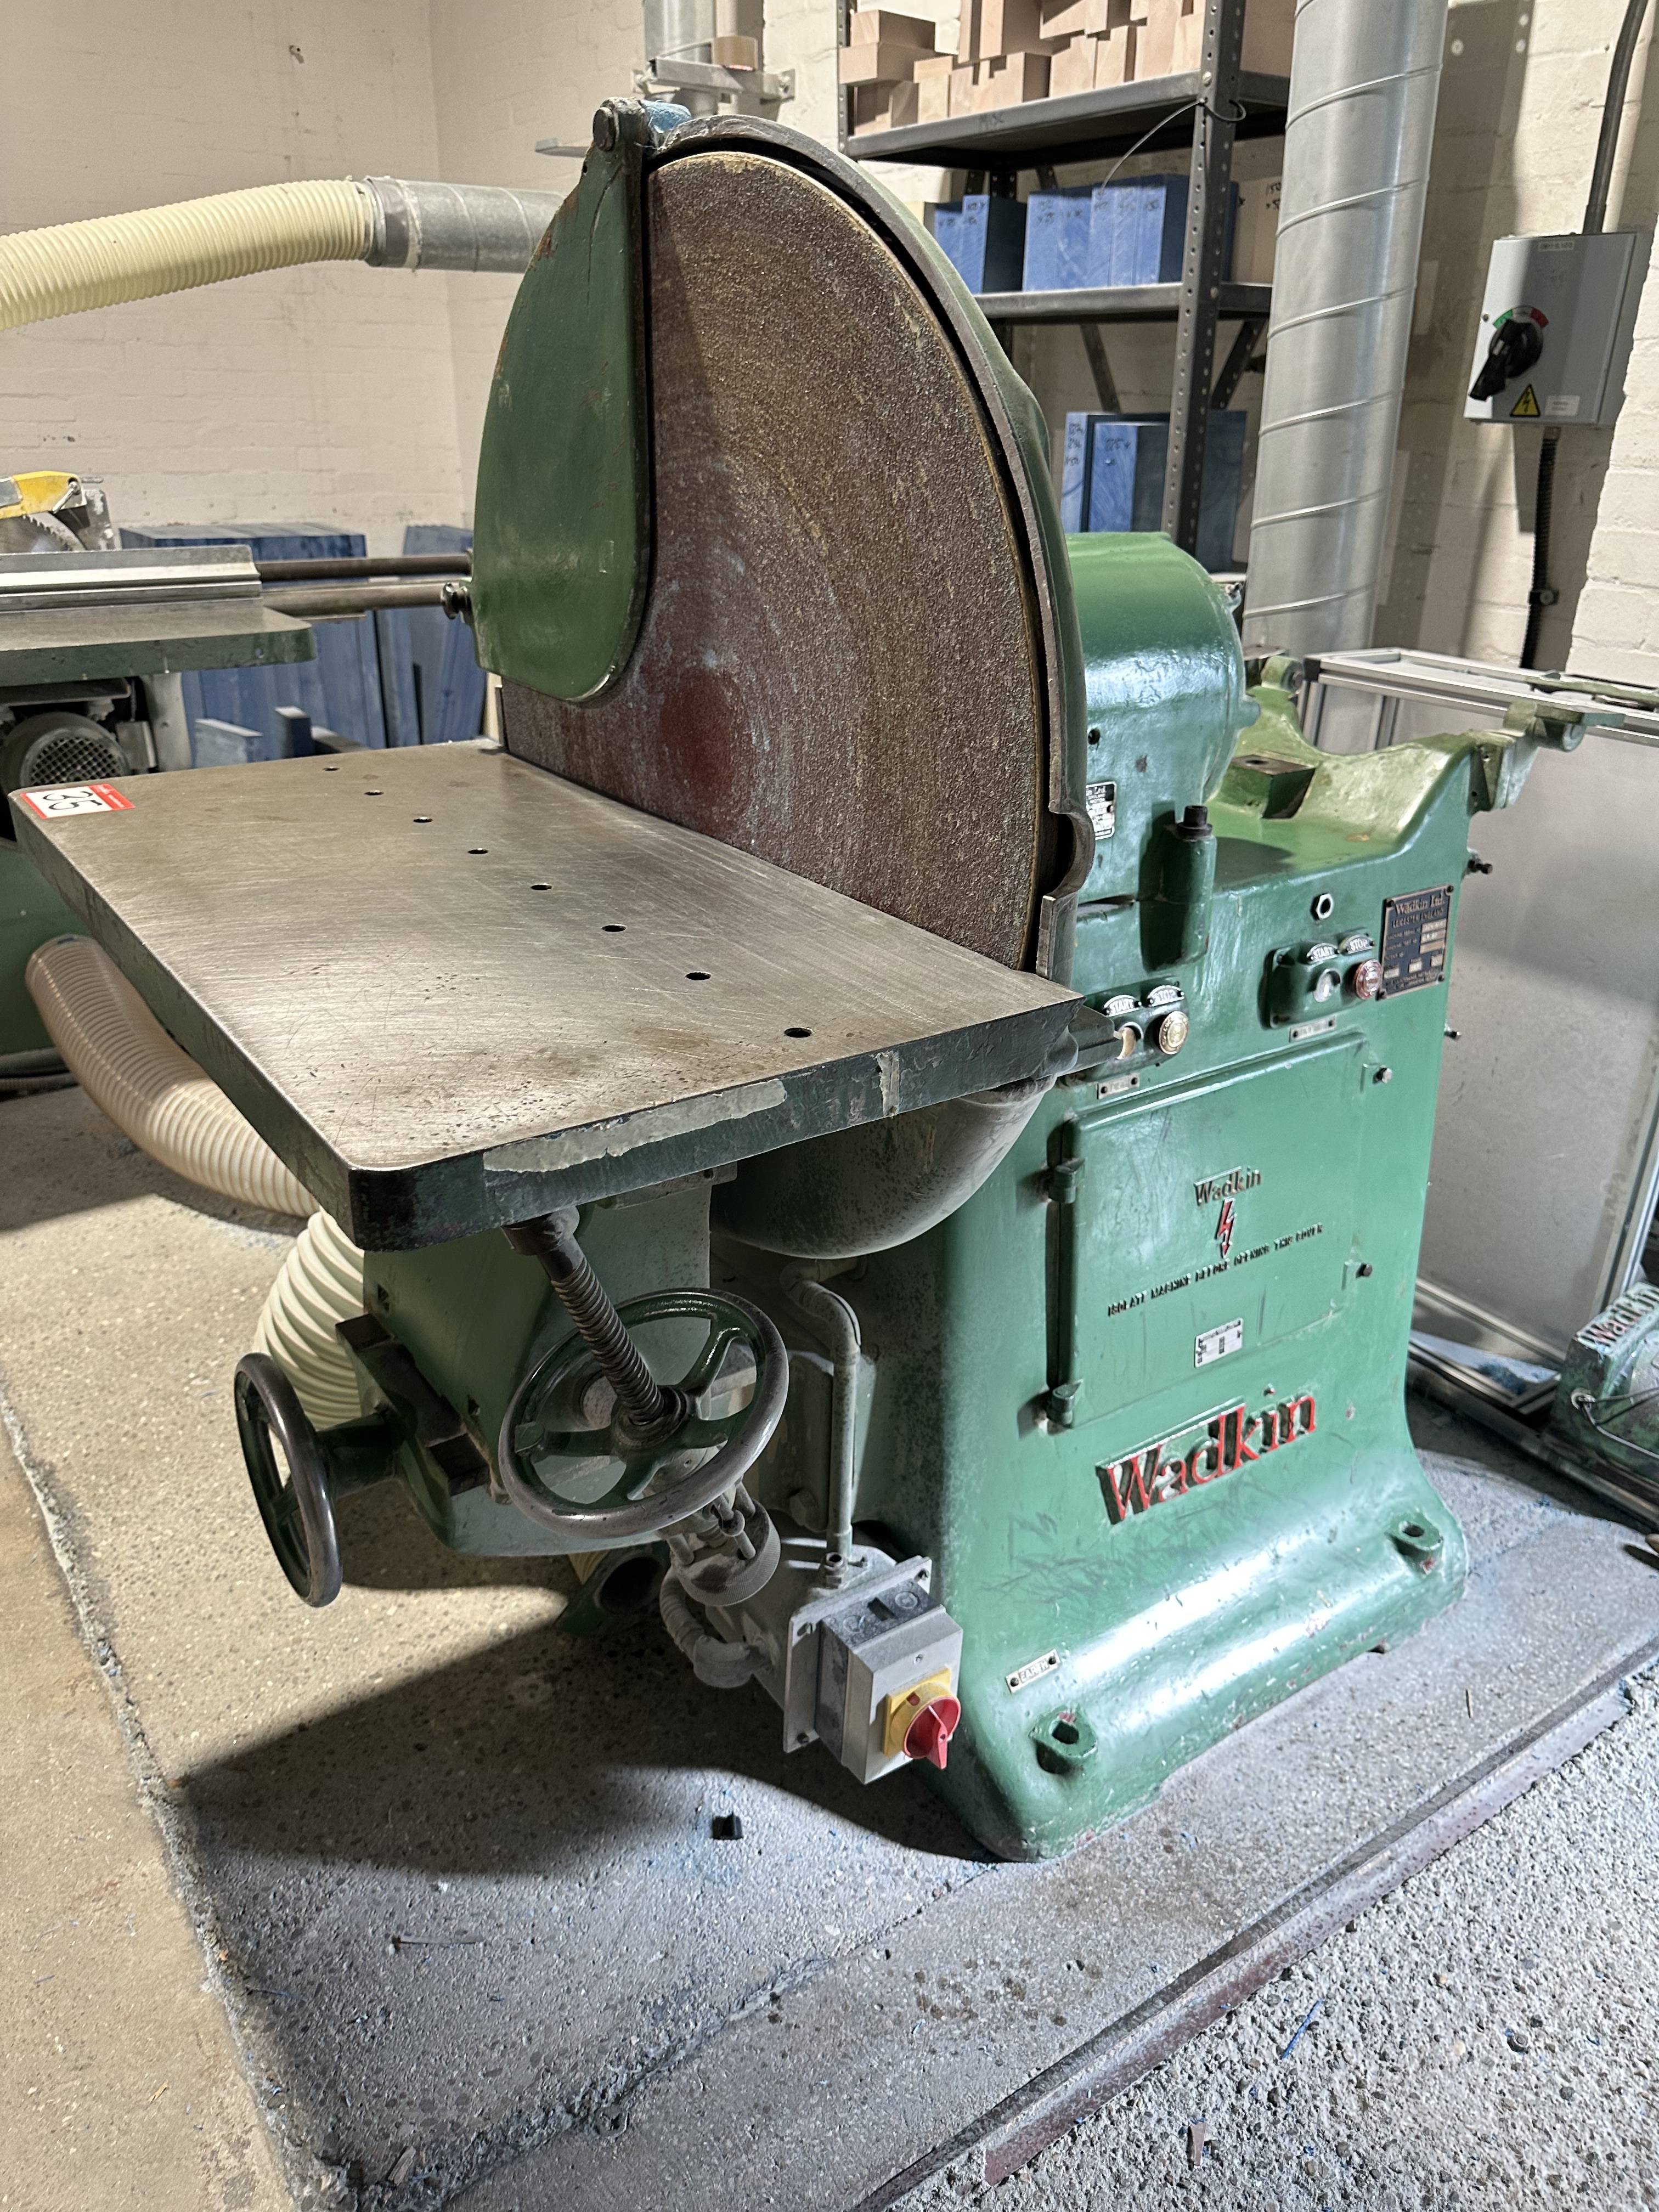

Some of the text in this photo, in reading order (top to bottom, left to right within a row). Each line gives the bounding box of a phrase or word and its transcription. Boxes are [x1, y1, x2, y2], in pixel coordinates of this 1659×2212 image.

[42, 791, 103, 810] 35
[1396, 899, 1427, 915] Wadkin
[1313, 947, 1334, 959] START
[1350, 939, 1368, 951] STOP
[1154, 989, 1176, 1002] STOP
[1109, 998, 1135, 1014] START
[1194, 1166, 1262, 1206] Wadkin
[1108, 1290, 1148, 1317] ISOLATE
[1150, 1272, 1192, 1299] MACHINE
[1195, 1257, 1230, 1282] BEFORE
[1295, 1222, 1323, 1242] COVER
[1096, 1383, 1317, 1525] Wadkin
[1020, 1659, 1050, 1683] EARTH
